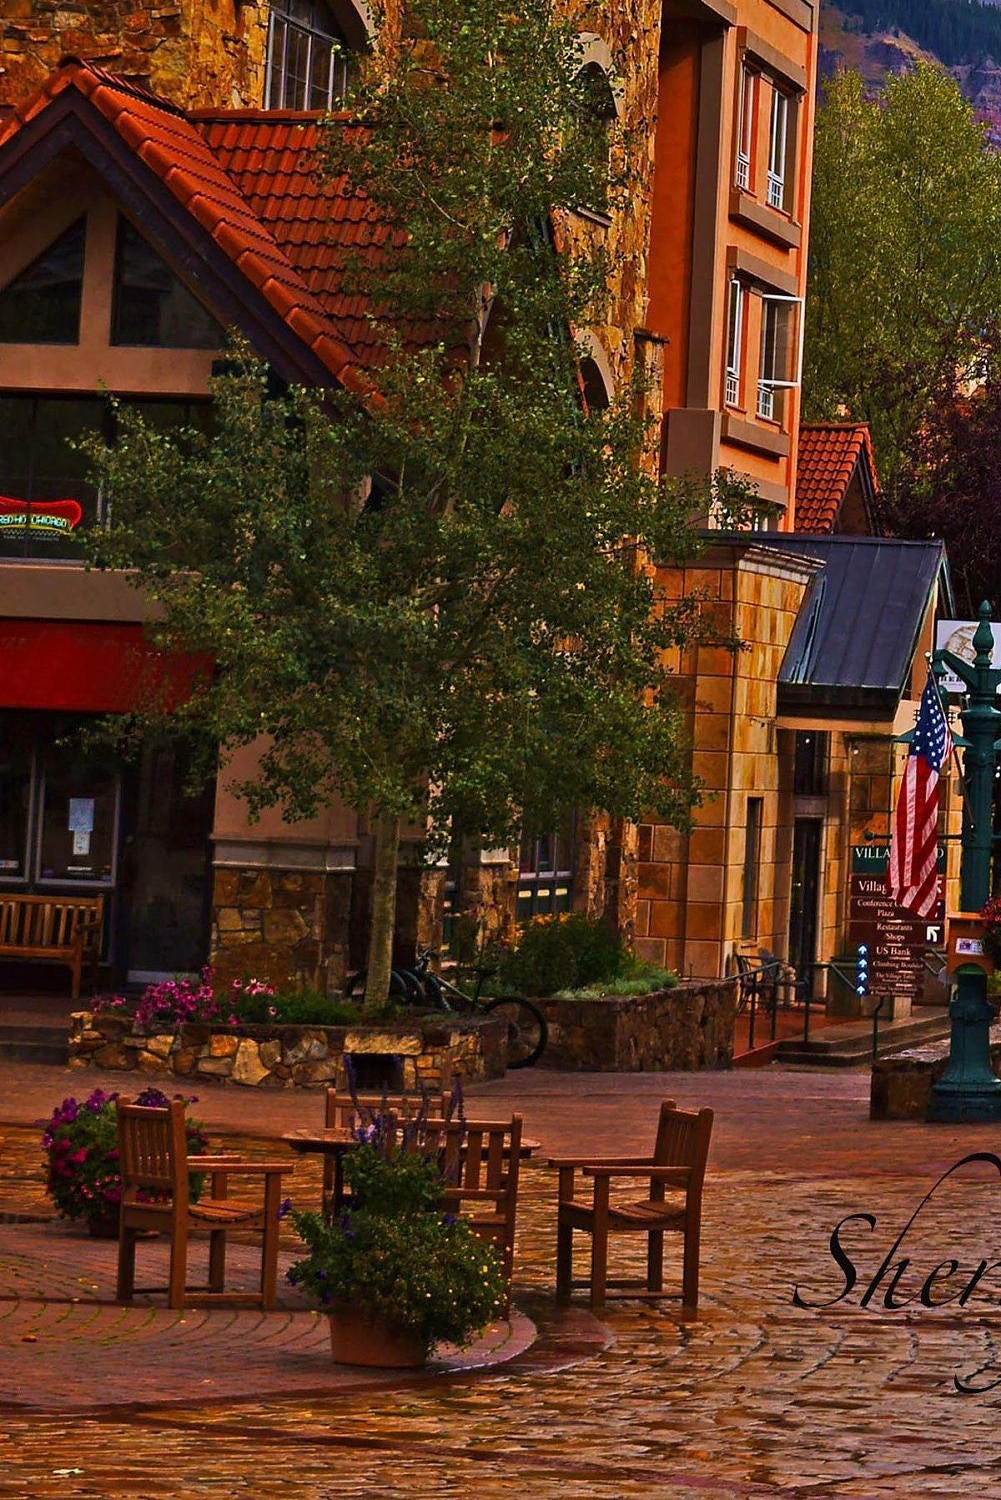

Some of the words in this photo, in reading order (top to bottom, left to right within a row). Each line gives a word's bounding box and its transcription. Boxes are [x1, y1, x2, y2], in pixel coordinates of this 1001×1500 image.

[857, 899, 893, 907] Conference
[877, 909, 895, 917] Plaza
[876, 946, 889, 955] US
[891, 947, 911, 956] Bank
